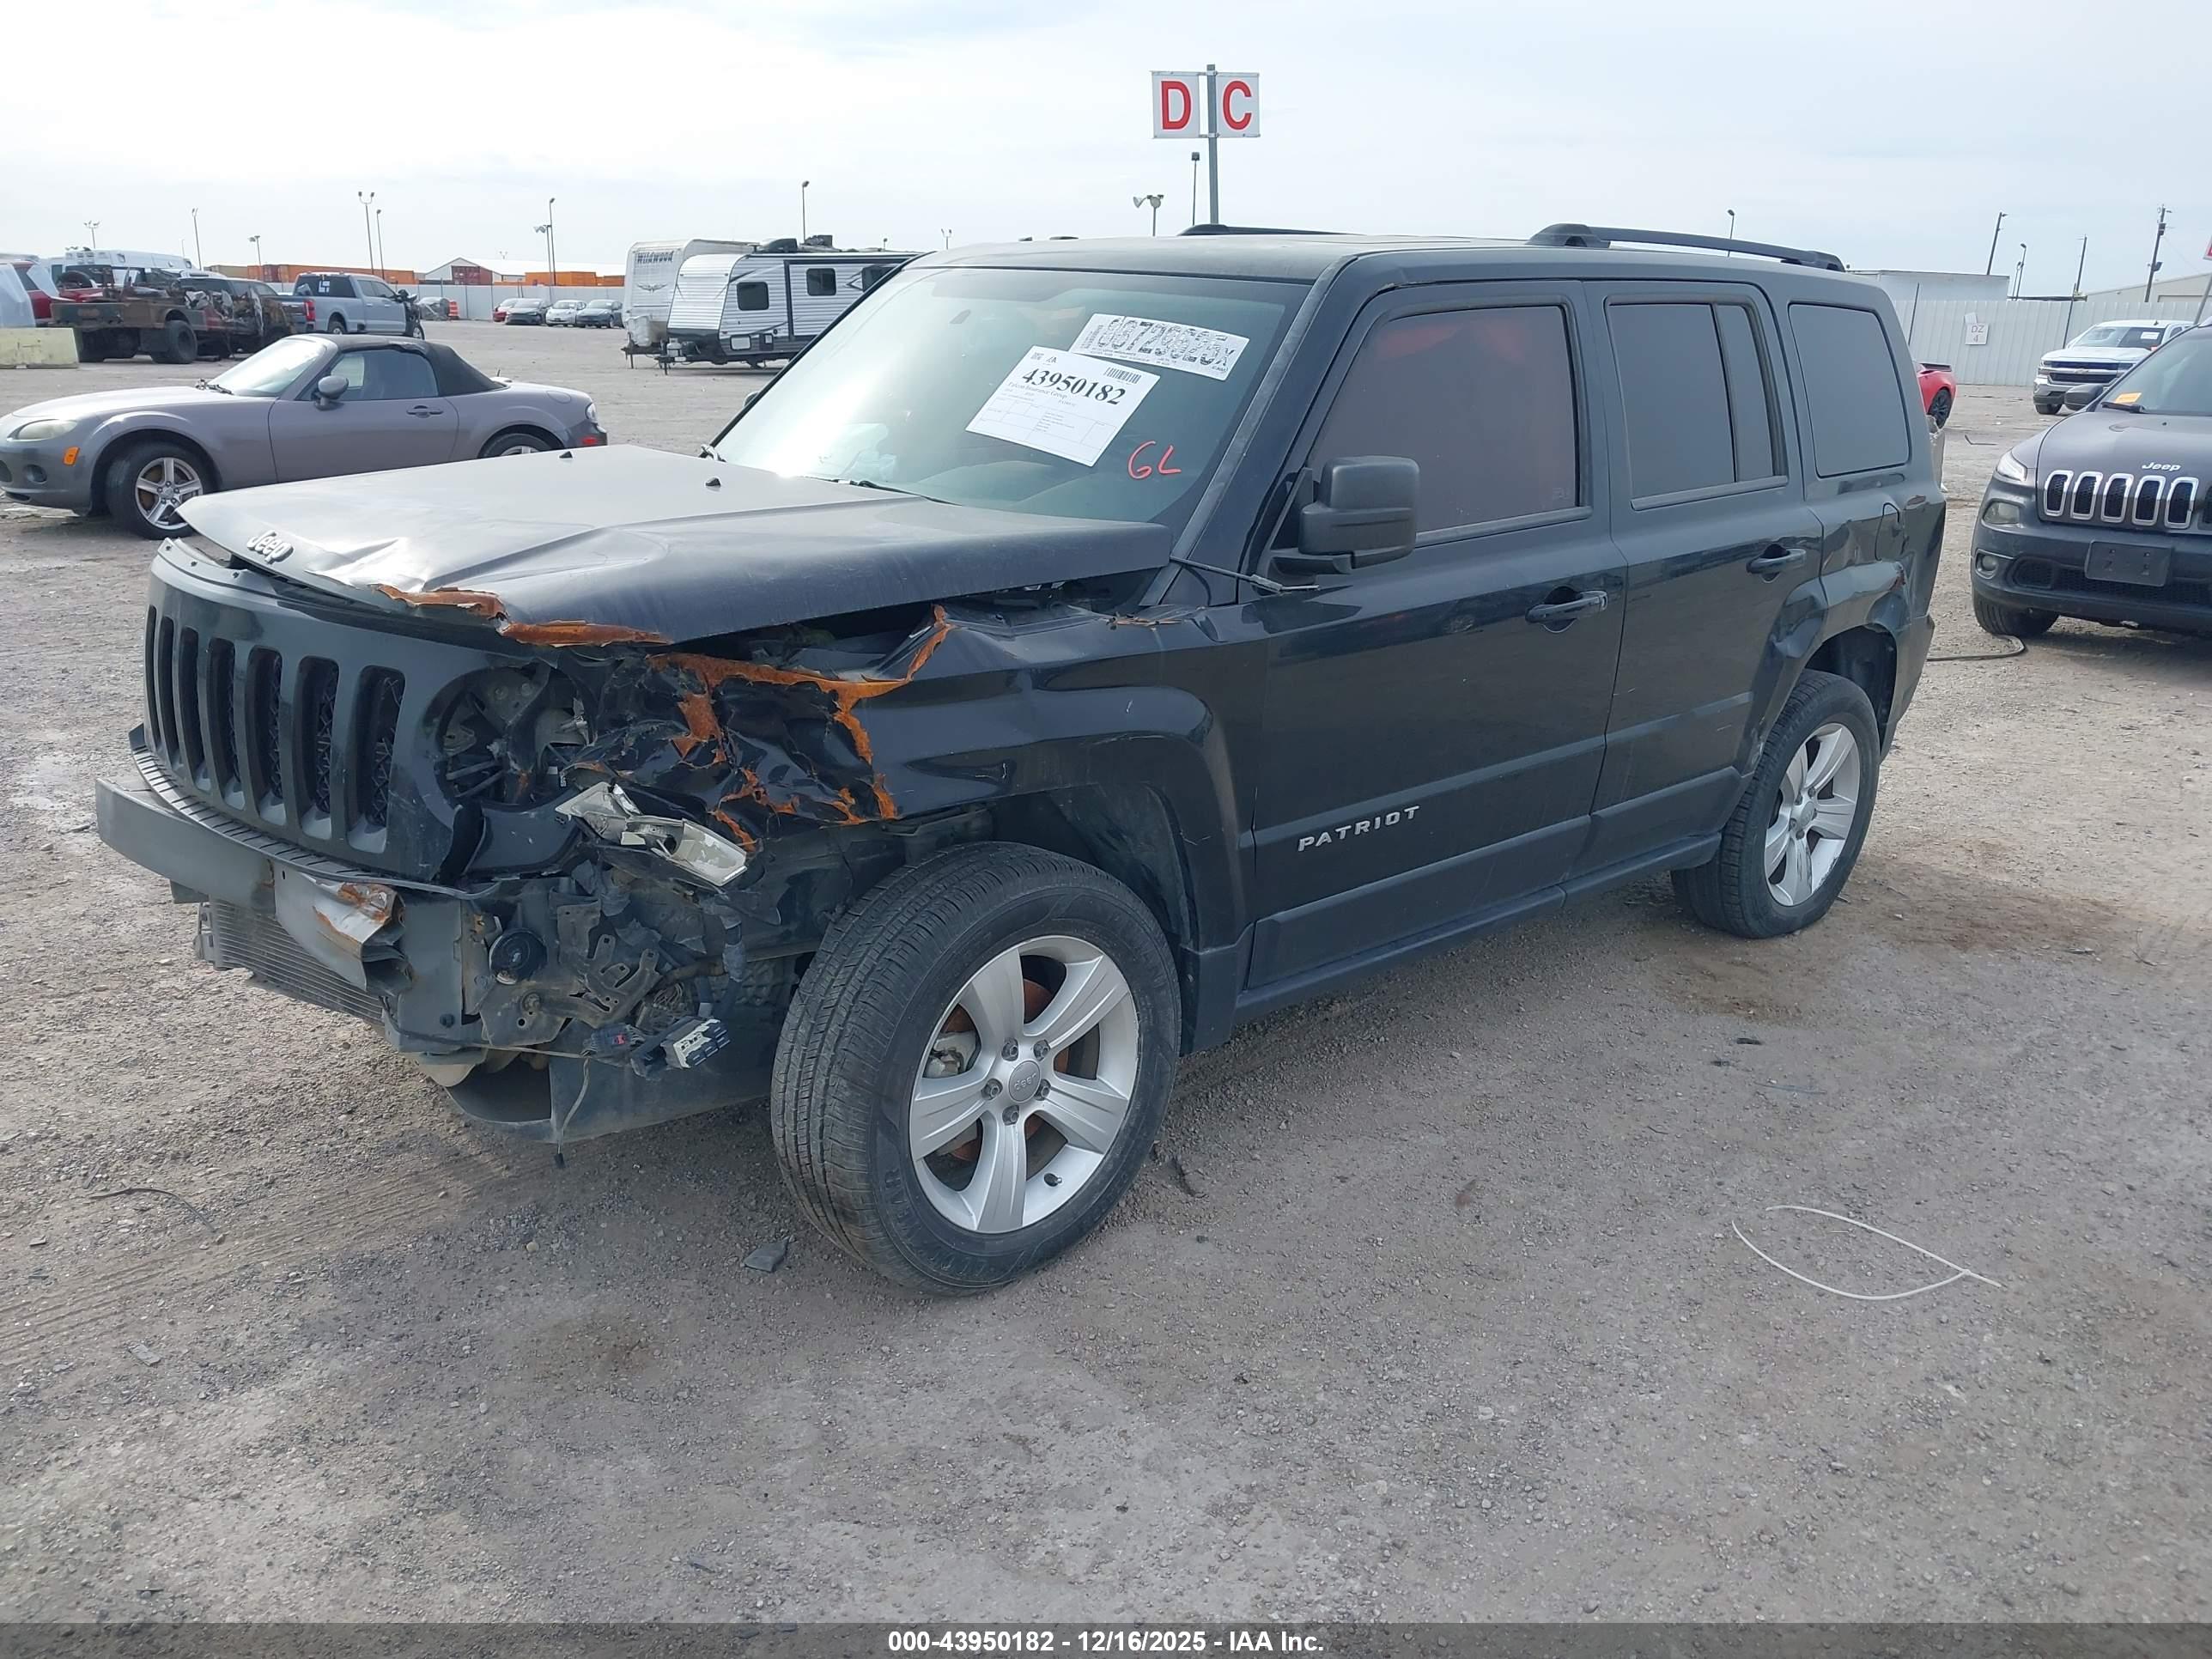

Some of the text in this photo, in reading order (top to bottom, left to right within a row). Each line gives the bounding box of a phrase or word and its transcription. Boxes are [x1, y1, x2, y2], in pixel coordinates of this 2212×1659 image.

[1161, 81, 1191, 130] D
[1223, 80, 1252, 131] C
[637, 251, 675, 264] Wildwood
[1022, 368, 1126, 405] 43950182
[2142, 461, 2182, 472] Jeep
[246, 529, 294, 565] Jeep
[1297, 805, 1420, 852] PATRIOT
